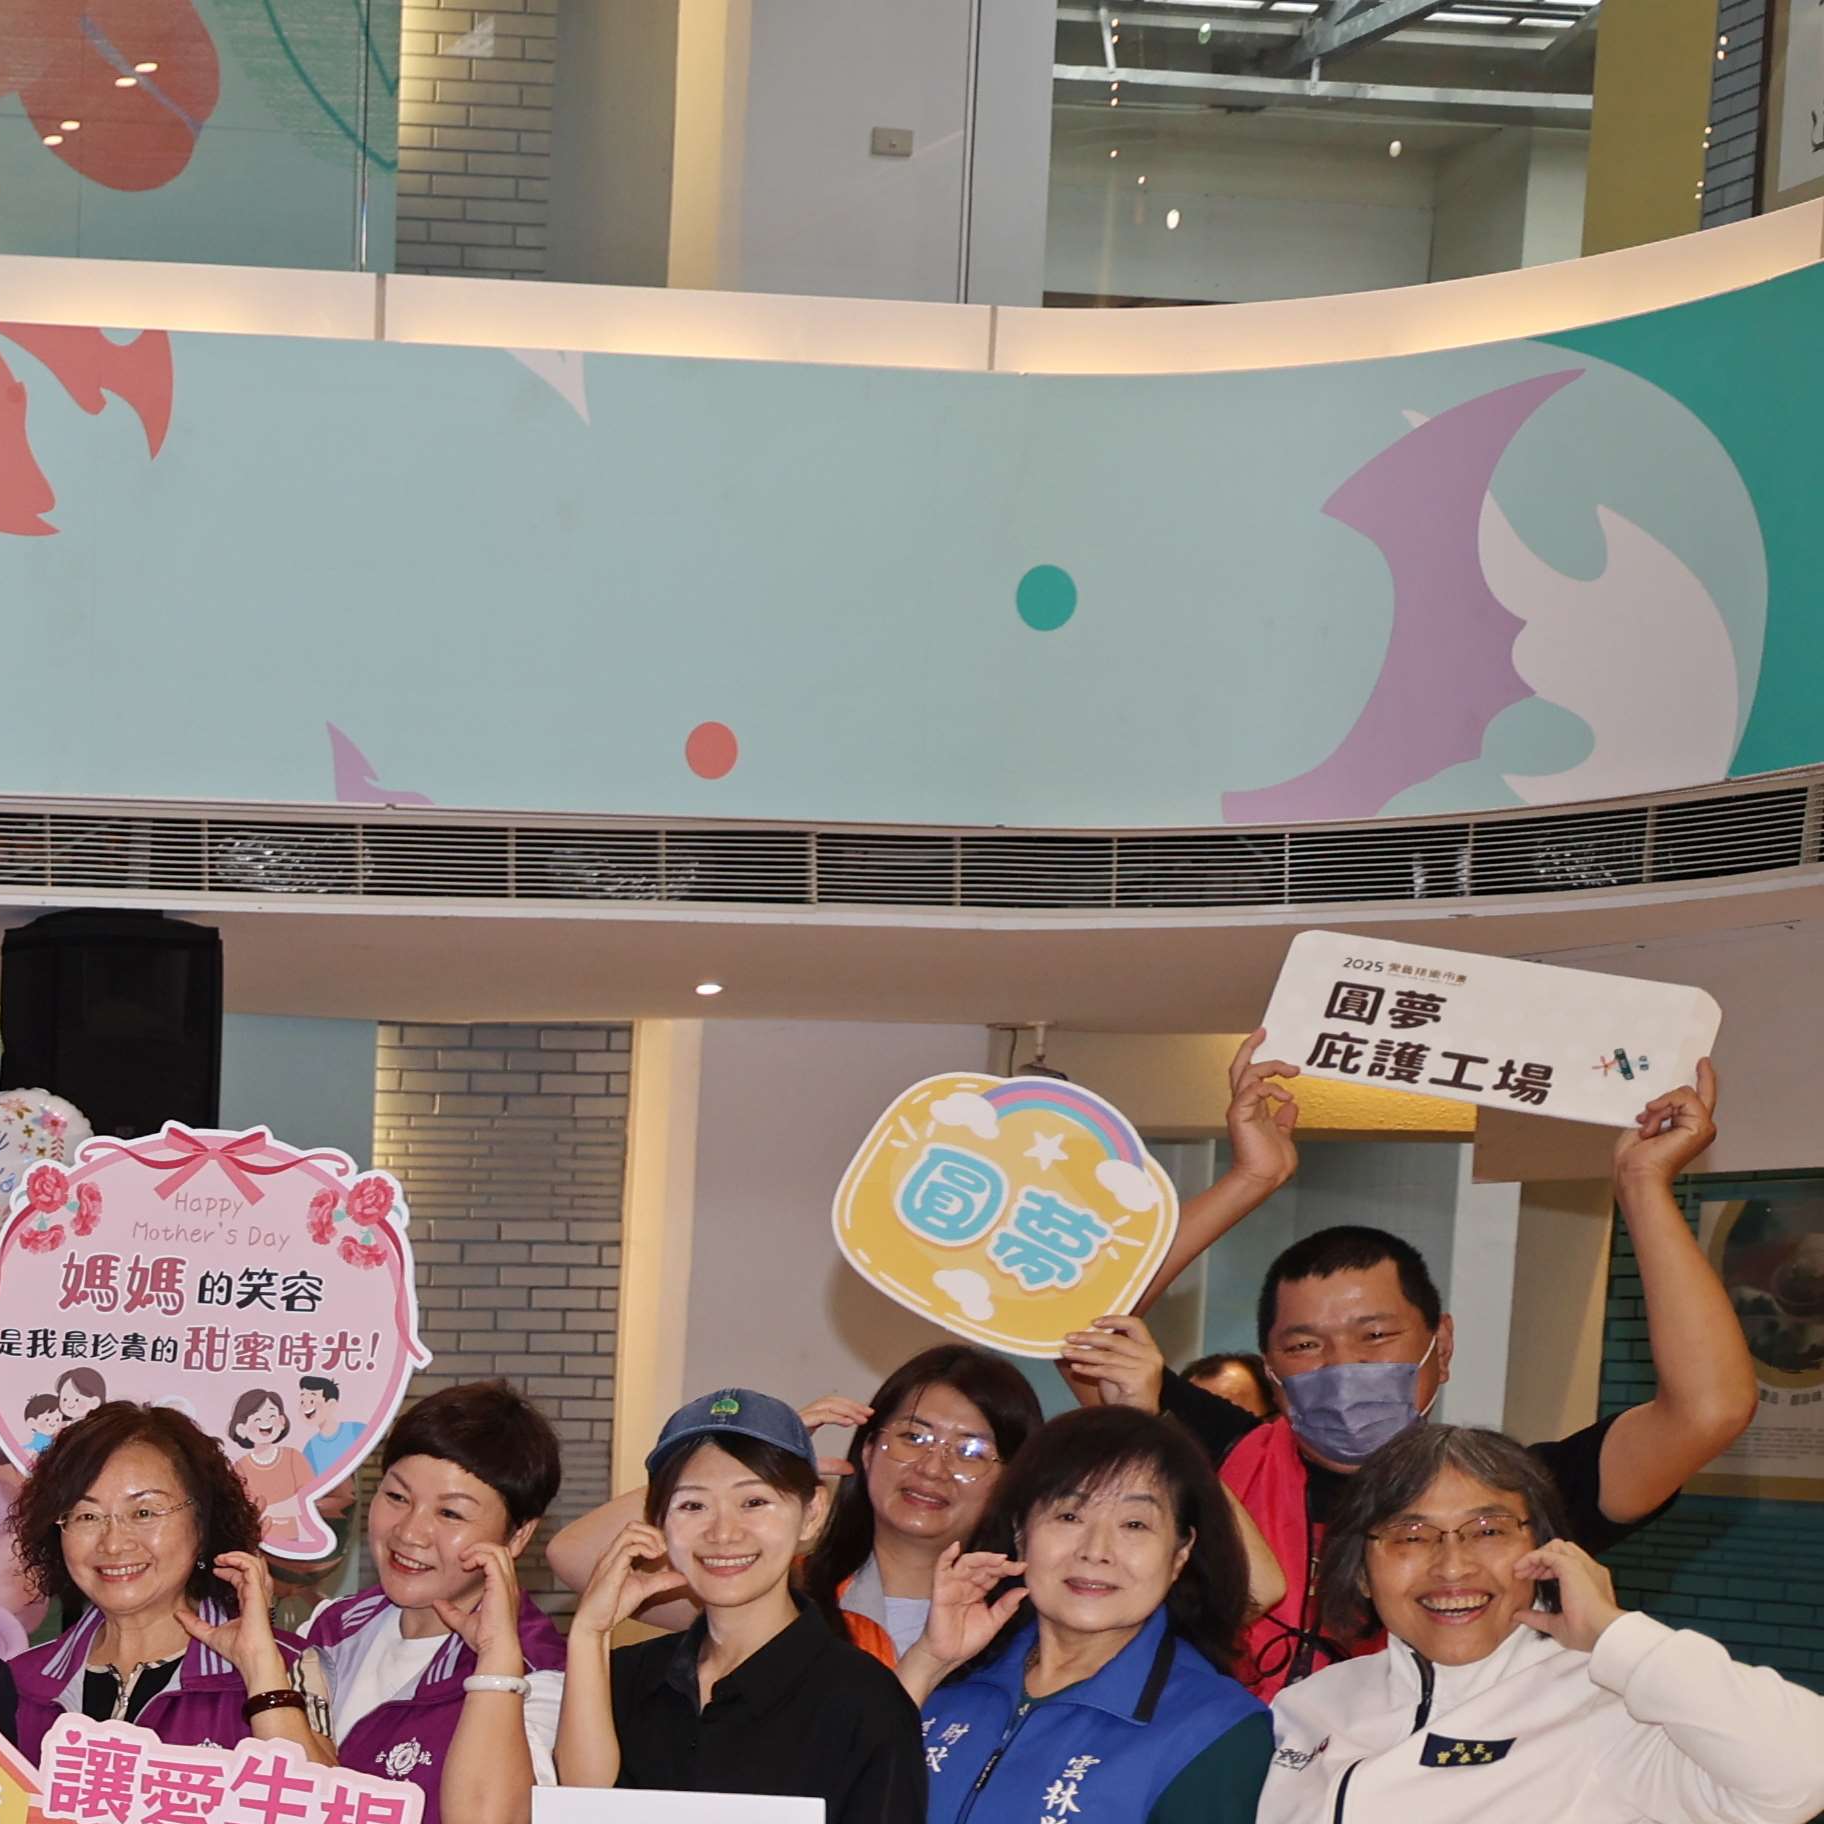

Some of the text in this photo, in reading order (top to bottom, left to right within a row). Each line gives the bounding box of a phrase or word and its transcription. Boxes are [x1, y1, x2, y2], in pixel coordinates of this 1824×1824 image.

[1343, 958, 1384, 973] 2025
[1324, 981, 1447, 1029] 圓夢
[1307, 1032, 1553, 1105] 庇護工場
[174, 1192, 244, 1219] Happy
[898, 1146, 1112, 1289] 圓夢
[132, 1221, 290, 1252] Mother's Day
[58, 1251, 323, 1315] 媽媽的笑容
